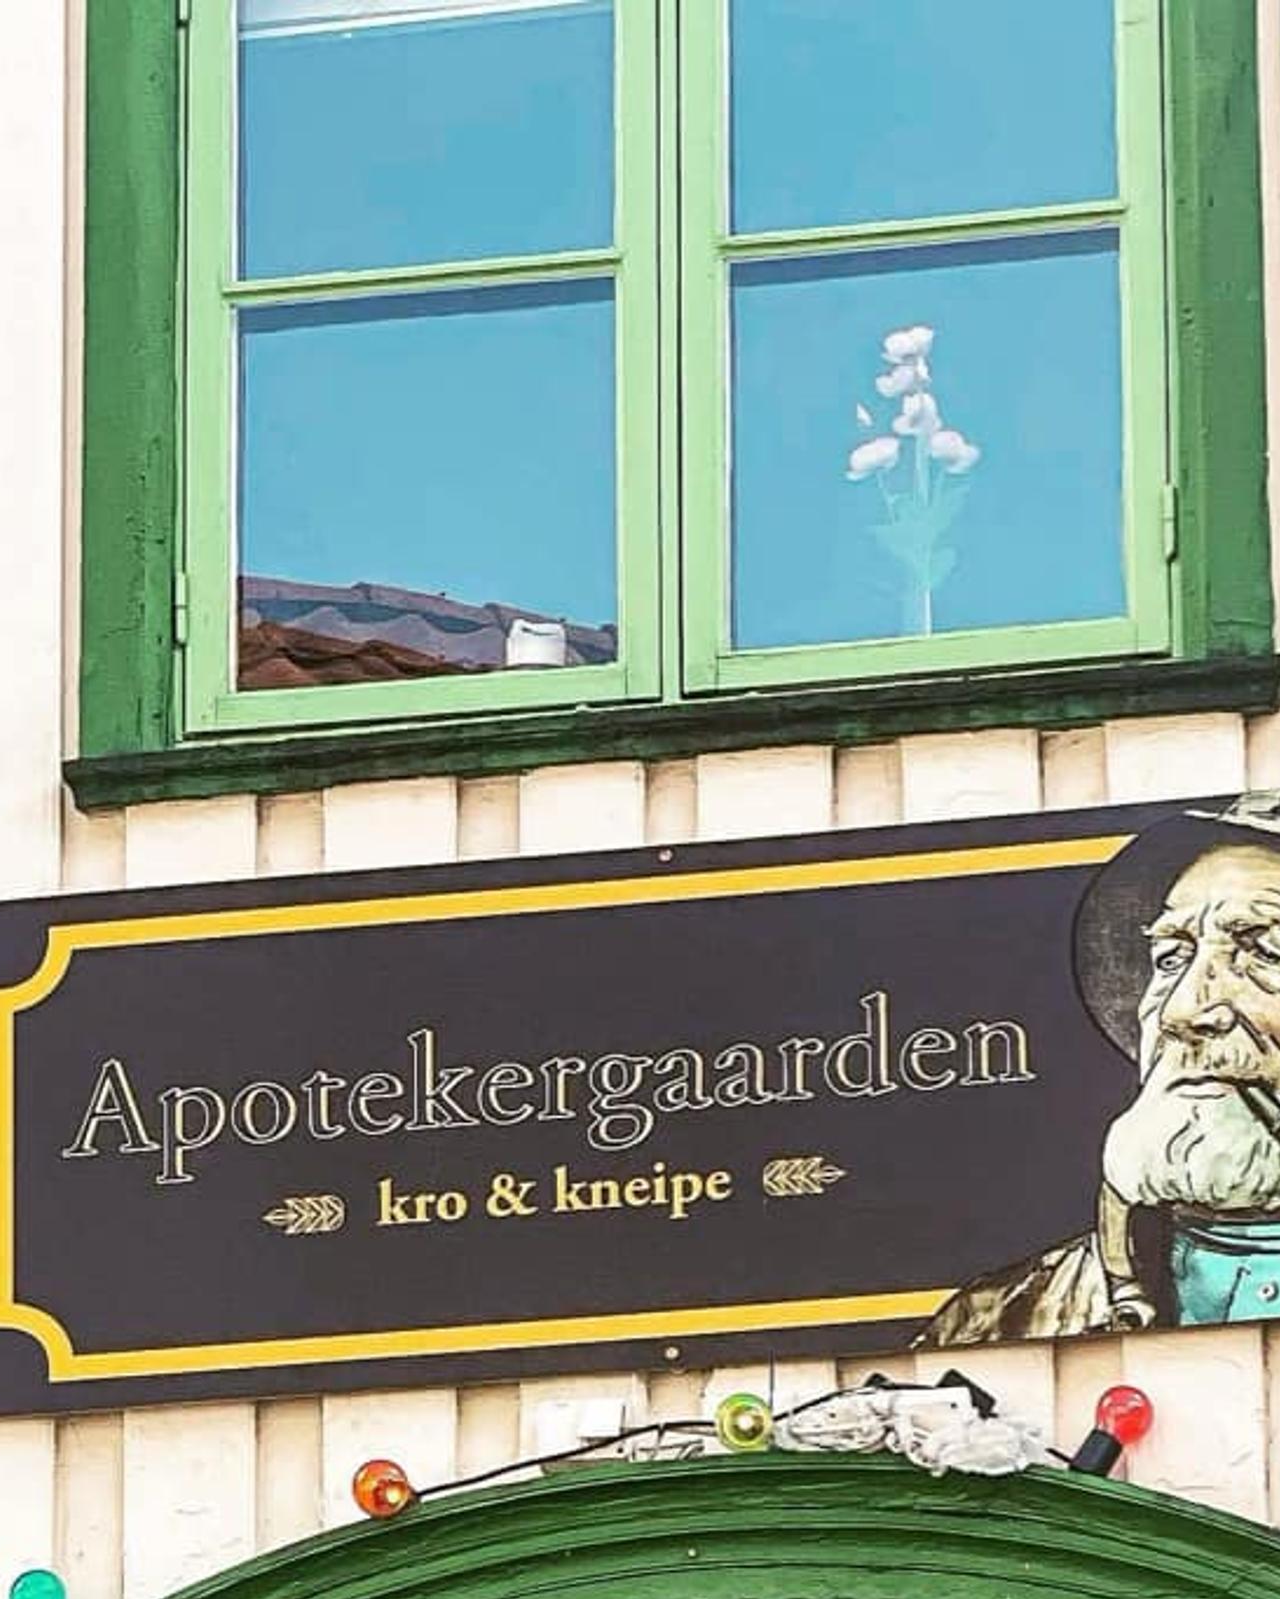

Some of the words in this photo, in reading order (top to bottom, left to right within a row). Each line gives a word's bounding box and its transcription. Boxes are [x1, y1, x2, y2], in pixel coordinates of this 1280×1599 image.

[62, 991, 1037, 1185] Apotekergaarden
[376, 1178, 468, 1227] kro
[486, 1172, 538, 1217] &
[552, 1162, 733, 1220] kneipe
